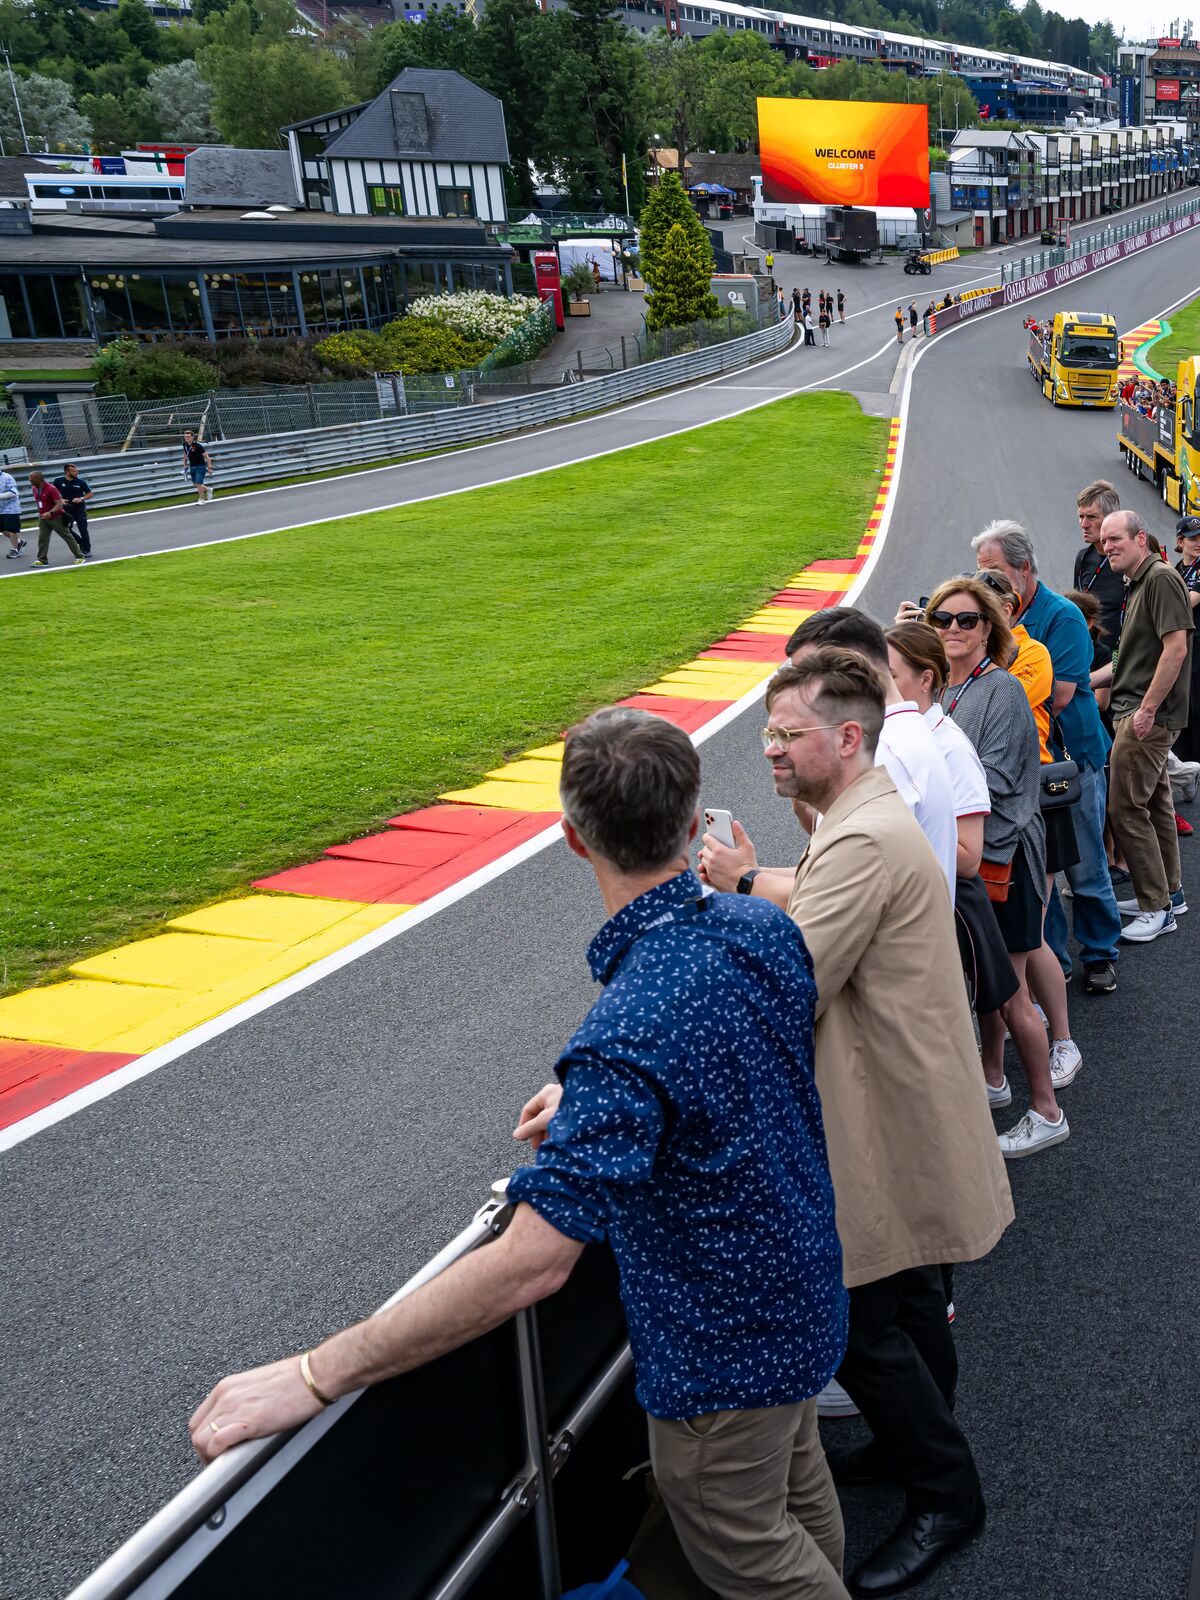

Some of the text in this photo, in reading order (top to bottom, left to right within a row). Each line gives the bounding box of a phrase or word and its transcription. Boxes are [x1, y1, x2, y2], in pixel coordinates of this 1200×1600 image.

[815, 148, 876, 160] WELCOME
[828, 162, 859, 170] CLUSTER
[1054, 257, 1088, 285] QATAR AIRWAYS
[1006, 272, 1048, 302] QATAR AIRWAYS
[959, 295, 992, 318] QATAR AIRWAYS
